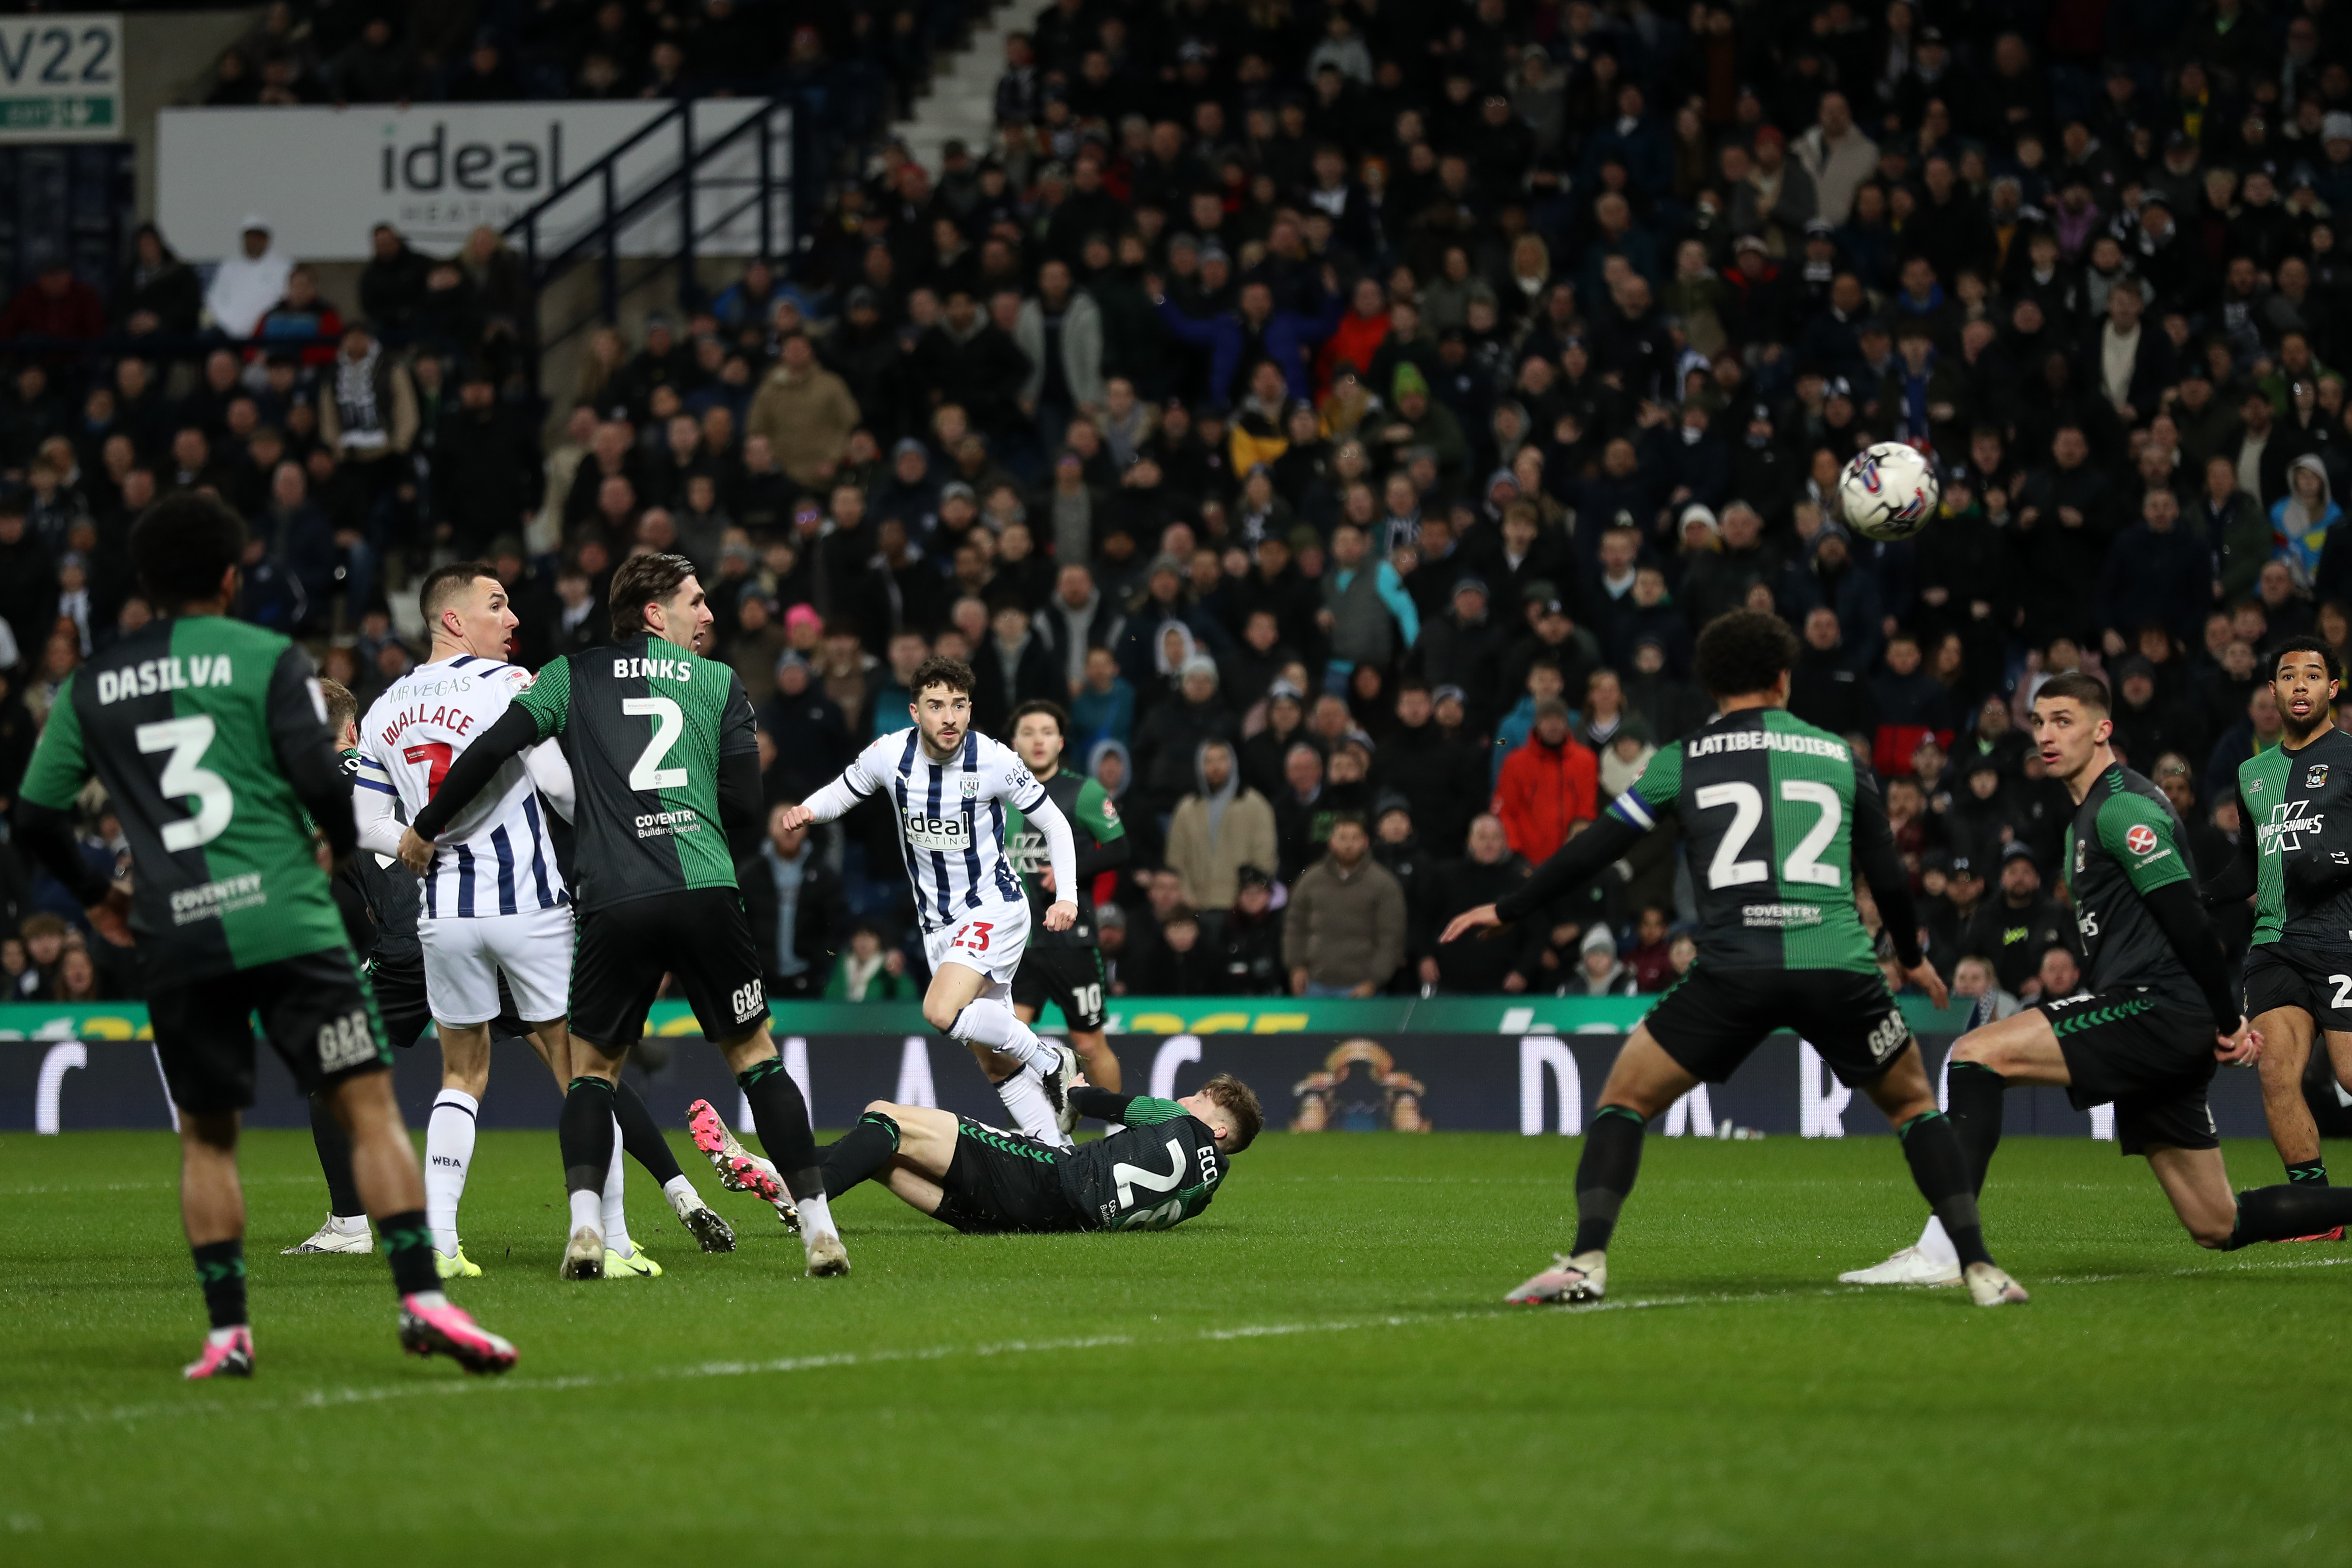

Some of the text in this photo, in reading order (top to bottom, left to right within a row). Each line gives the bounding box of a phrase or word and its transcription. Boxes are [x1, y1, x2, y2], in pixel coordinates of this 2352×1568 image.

[0, 28, 112, 83] V22
[381, 120, 562, 190] ideal
[98, 655, 232, 705] DASILVA
[613, 658, 691, 682] BINKS
[390, 677, 472, 704] MR VEGAS
[381, 703, 475, 747] WALLACE
[622, 697, 688, 792] 2
[135, 714, 234, 853] 3
[1005, 758, 1024, 786] BAR
[1016, 768, 1029, 788] BO
[402, 742, 453, 834] 7
[636, 810, 696, 827] COVENTRY
[638, 824, 701, 838] Building Society
[903, 807, 968, 835] ideal
[2281, 814, 2324, 834] SHAVES
[907, 832, 969, 845] HEATING
[1695, 780, 1842, 890] 22
[2142, 848, 2172, 865] MOTORS
[2331, 851, 2350, 864] 27
[1742, 904, 1821, 918] COVENTRY
[732, 978, 763, 1015] G&R
[1072, 983, 1102, 1017] 10
[318, 1011, 373, 1060] G&R
[1868, 1009, 1905, 1056] G&R
[432, 1155, 462, 1168] WBA
